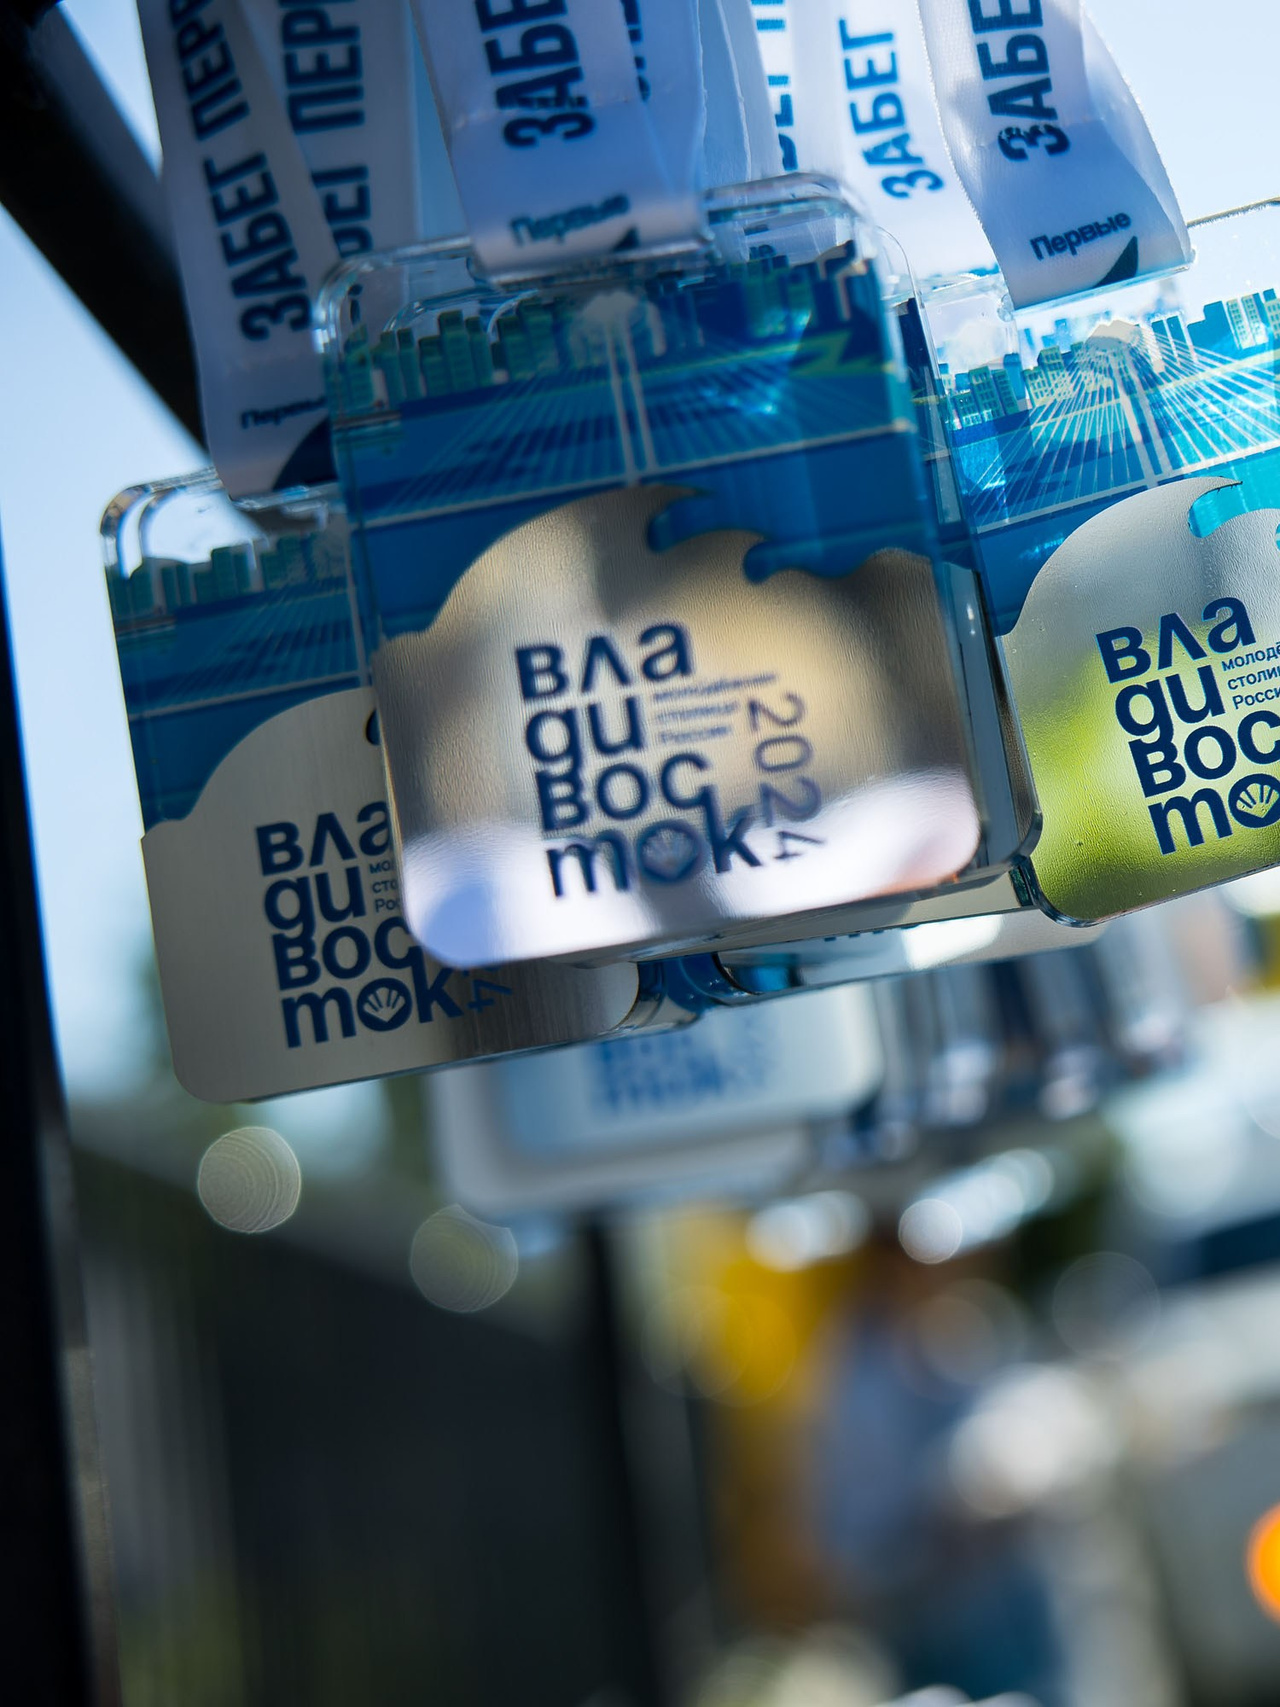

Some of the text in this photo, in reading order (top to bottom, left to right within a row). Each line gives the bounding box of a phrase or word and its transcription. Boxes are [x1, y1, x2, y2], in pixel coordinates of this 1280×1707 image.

[278, 0, 366, 136] ПЕР
[839, 18, 944, 199] ЗАБЕГ
[203, 152, 311, 341] ЗАБЕГ
[1030, 212, 1131, 261] Первые
